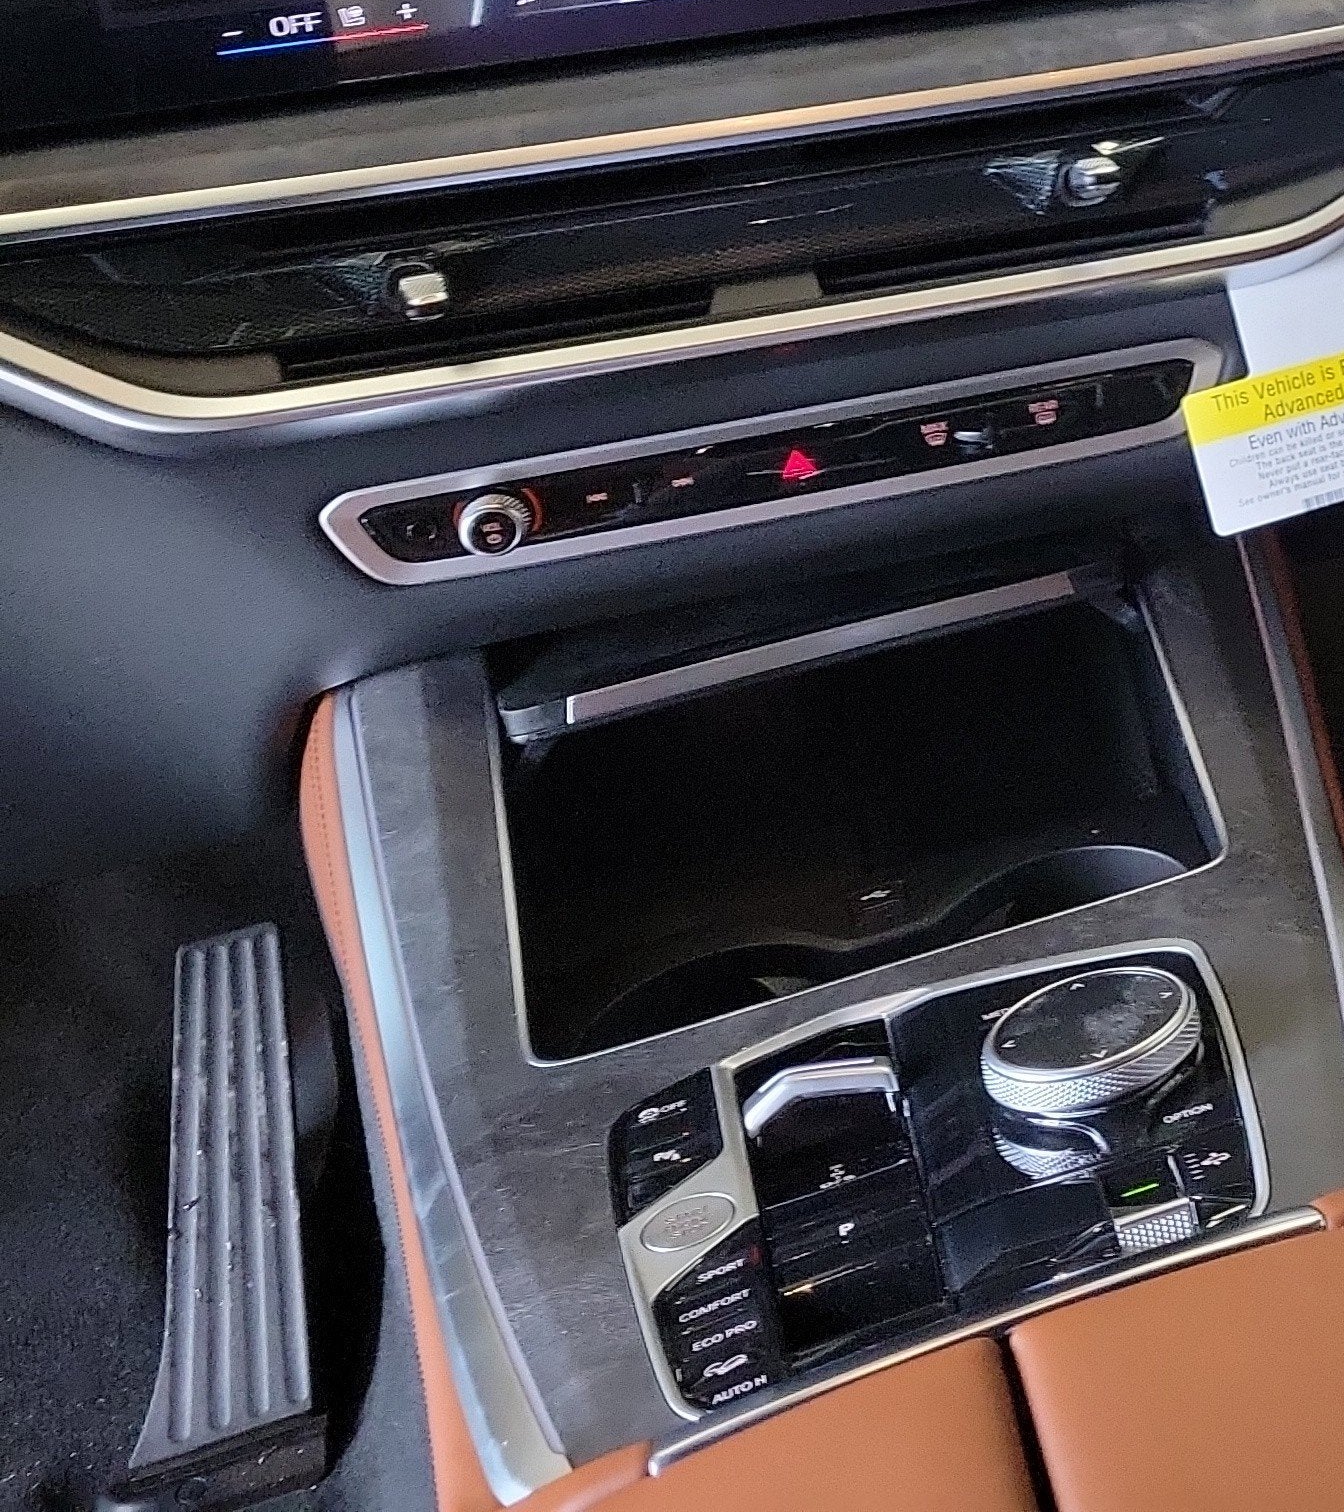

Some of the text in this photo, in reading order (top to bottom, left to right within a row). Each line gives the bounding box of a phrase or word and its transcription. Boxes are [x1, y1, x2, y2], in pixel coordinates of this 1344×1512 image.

[268, 11, 323, 37] OFF
[1211, 390, 1250, 411] This
[1252, 370, 1316, 400] Vehicle
[1319, 365, 1336, 382] is
[1248, 430, 1283, 450] Even
[1285, 420, 1317, 439] with
[1162, 1102, 1214, 1124] OPTION
[696, 1257, 746, 1283] SPORT
[678, 1287, 751, 1323] COMFORT
[691, 1320, 758, 1352] ECO PRO
[711, 1374, 768, 1405] AUTO H
